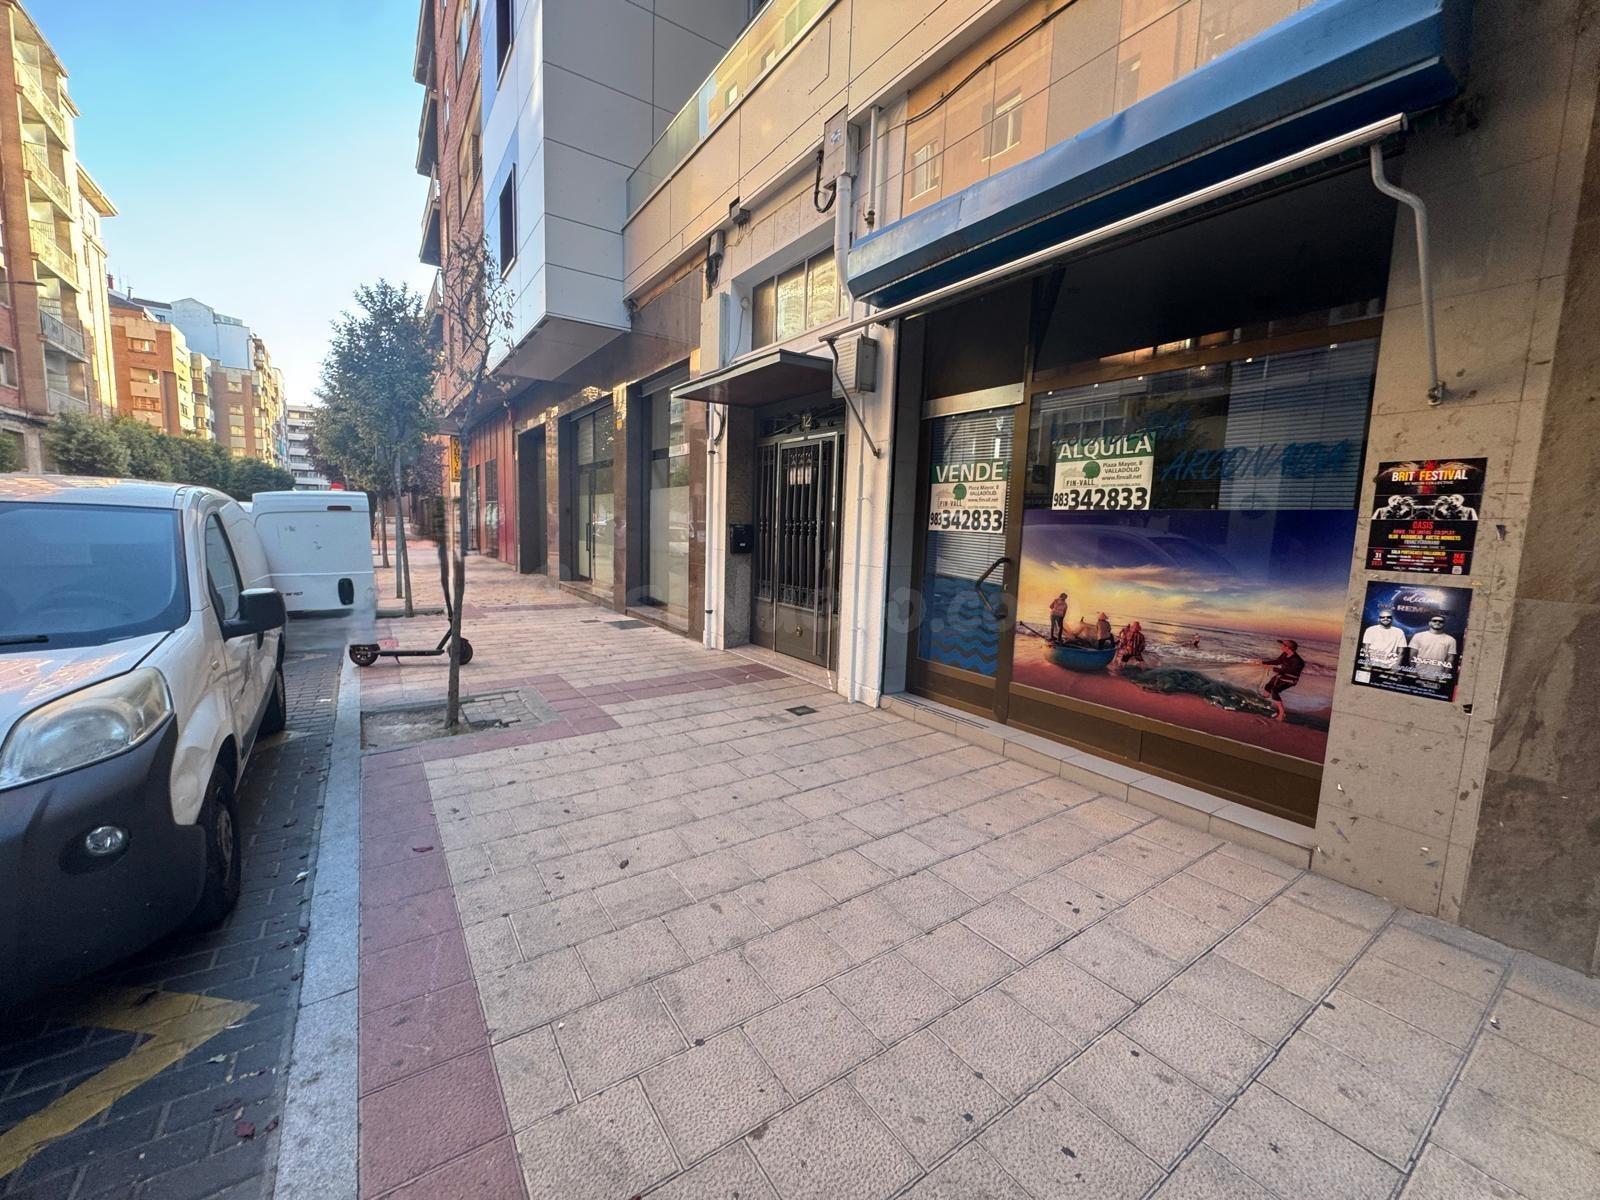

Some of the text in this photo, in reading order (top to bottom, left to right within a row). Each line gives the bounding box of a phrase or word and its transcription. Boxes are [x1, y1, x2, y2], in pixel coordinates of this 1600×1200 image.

[1057, 433, 1153, 460] ALQUILA
[935, 461, 1004, 483] VENDE
[1104, 466, 1140, 474] VALLADOLID
[1391, 469, 1468, 482] BRIT FESTIVAL
[1066, 479, 1096, 487] FIN-VALL
[1412, 520, 1434, 529] OASIS
